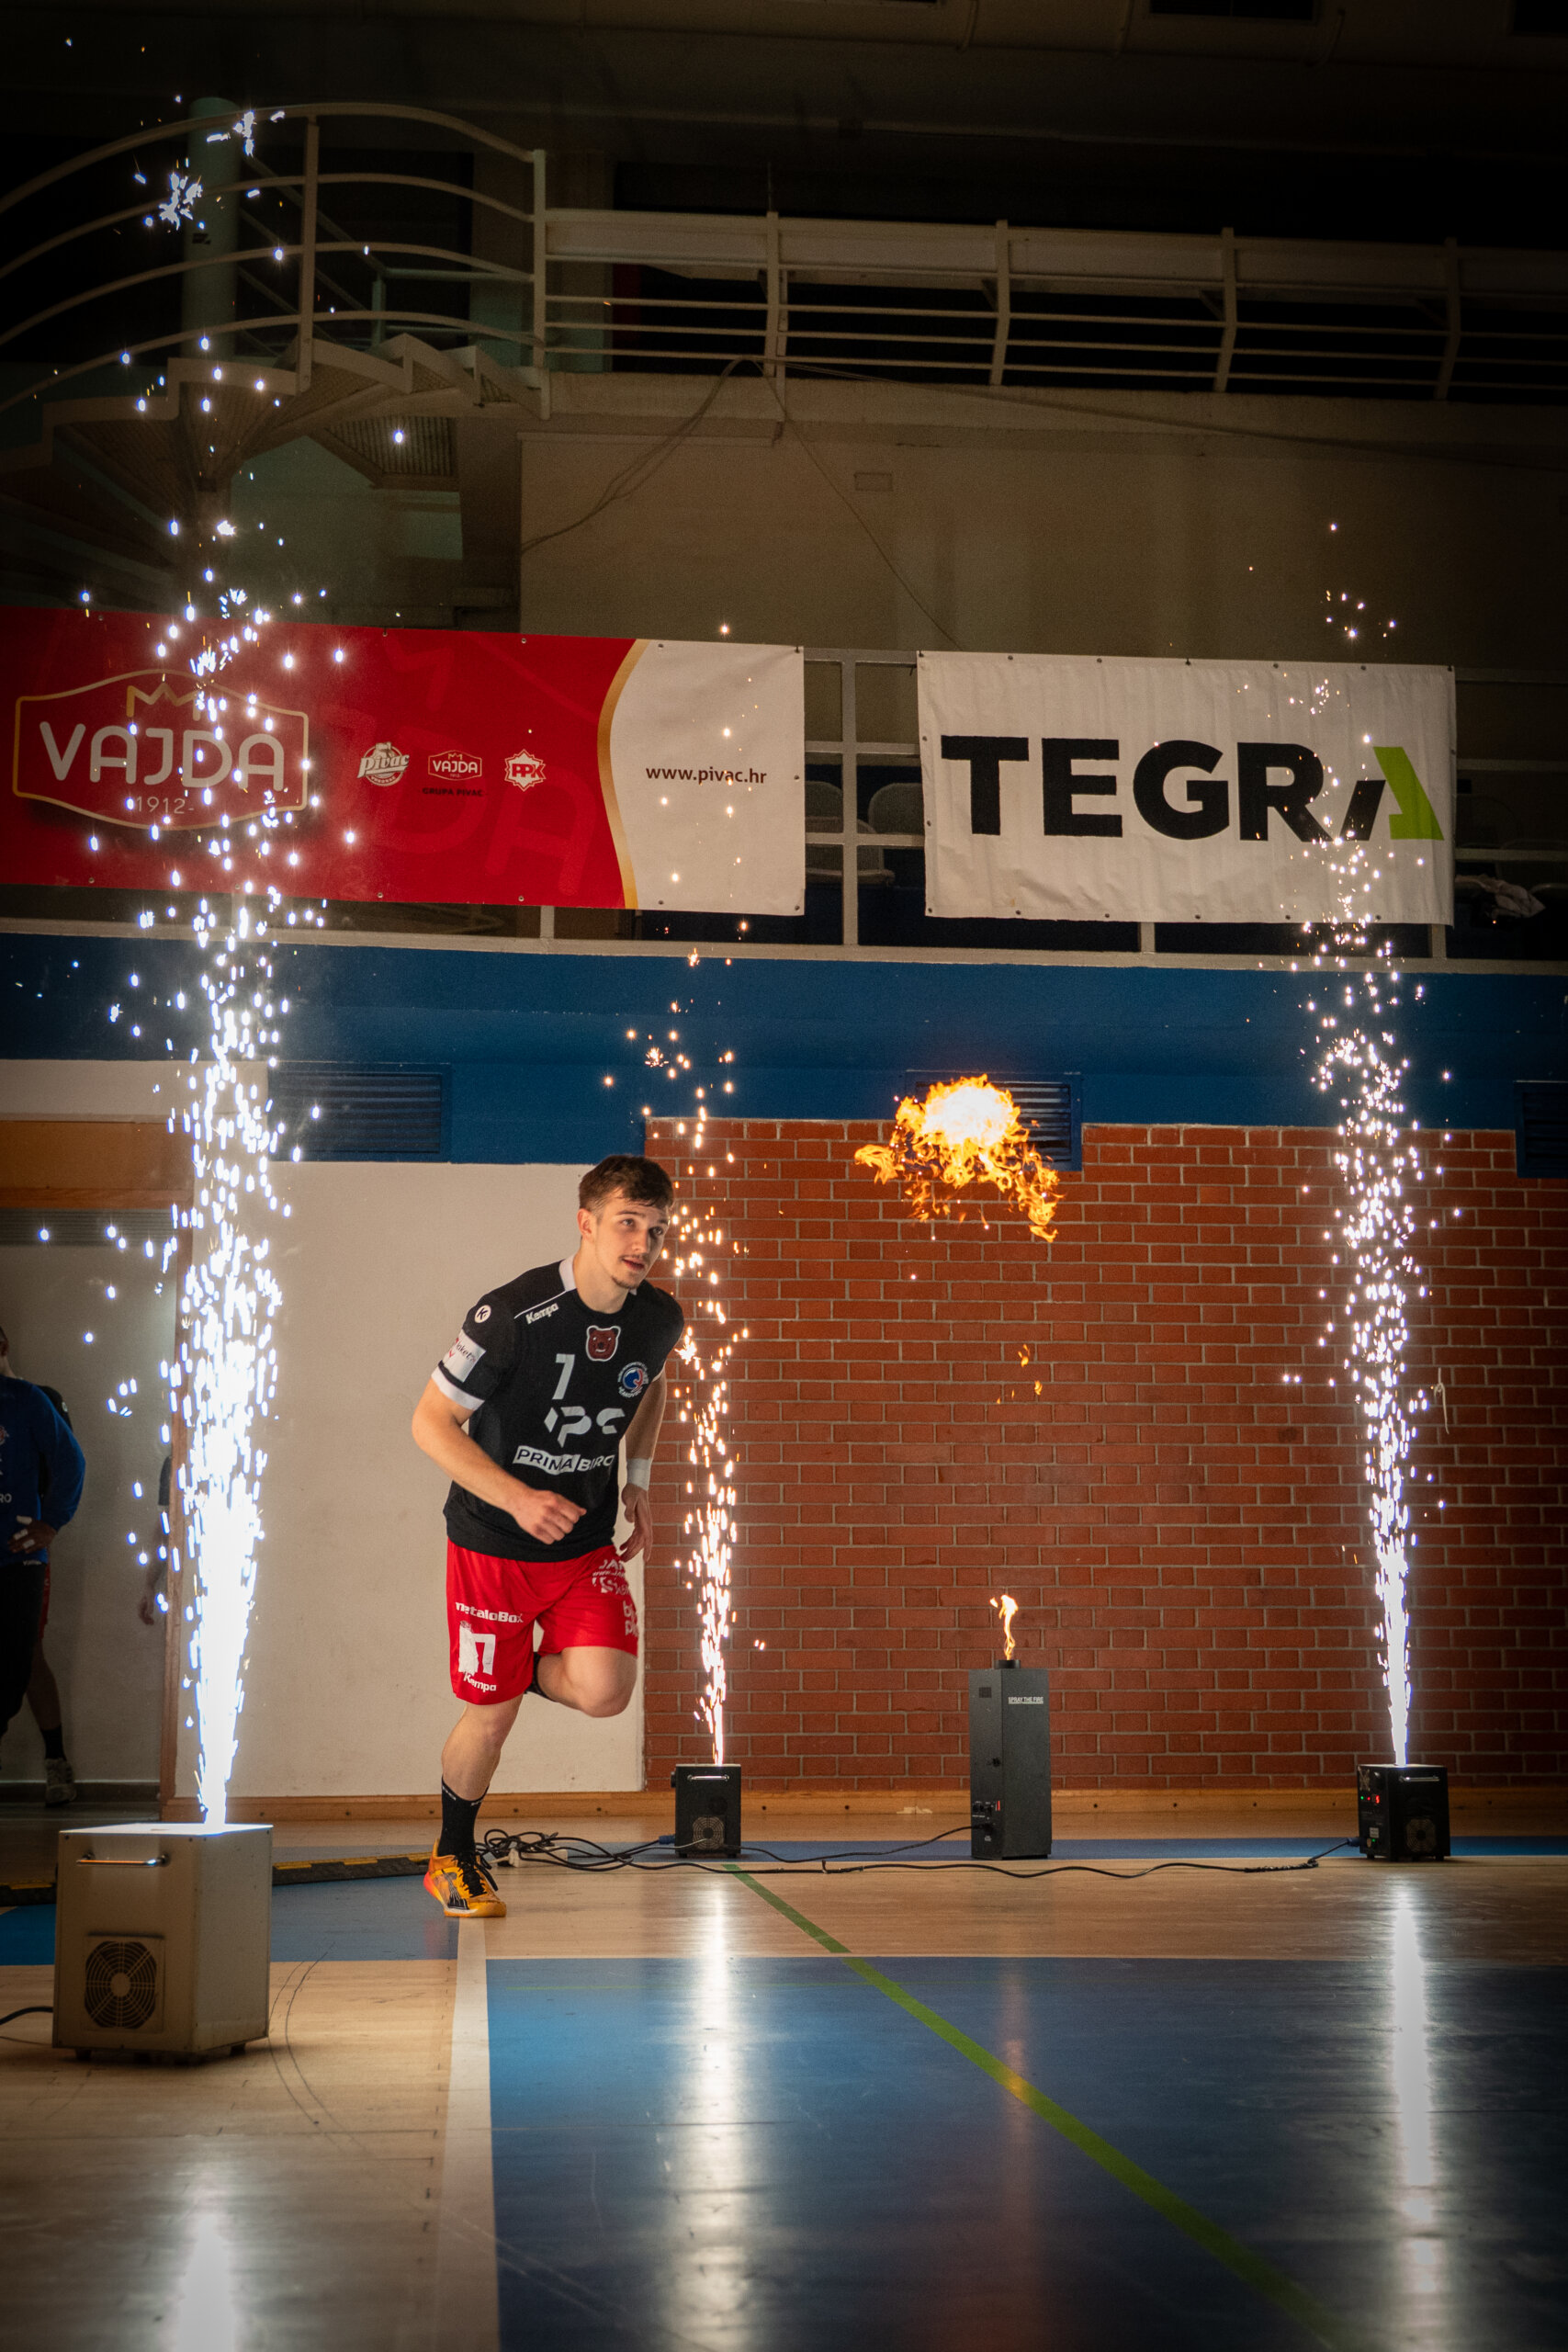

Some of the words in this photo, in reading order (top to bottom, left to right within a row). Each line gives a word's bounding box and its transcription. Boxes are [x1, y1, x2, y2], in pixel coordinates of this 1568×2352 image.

[39, 721, 285, 791] VAJDA
[432, 760, 479, 774] VAJDA
[646, 766, 767, 785] www.pivac.hr
[422, 787, 455, 797] GRUPA
[457, 788, 484, 797] PIVAC
[941, 735, 1444, 842] TEGRA
[525, 1303, 559, 1325] Kempa
[552, 1353, 576, 1400] 7
